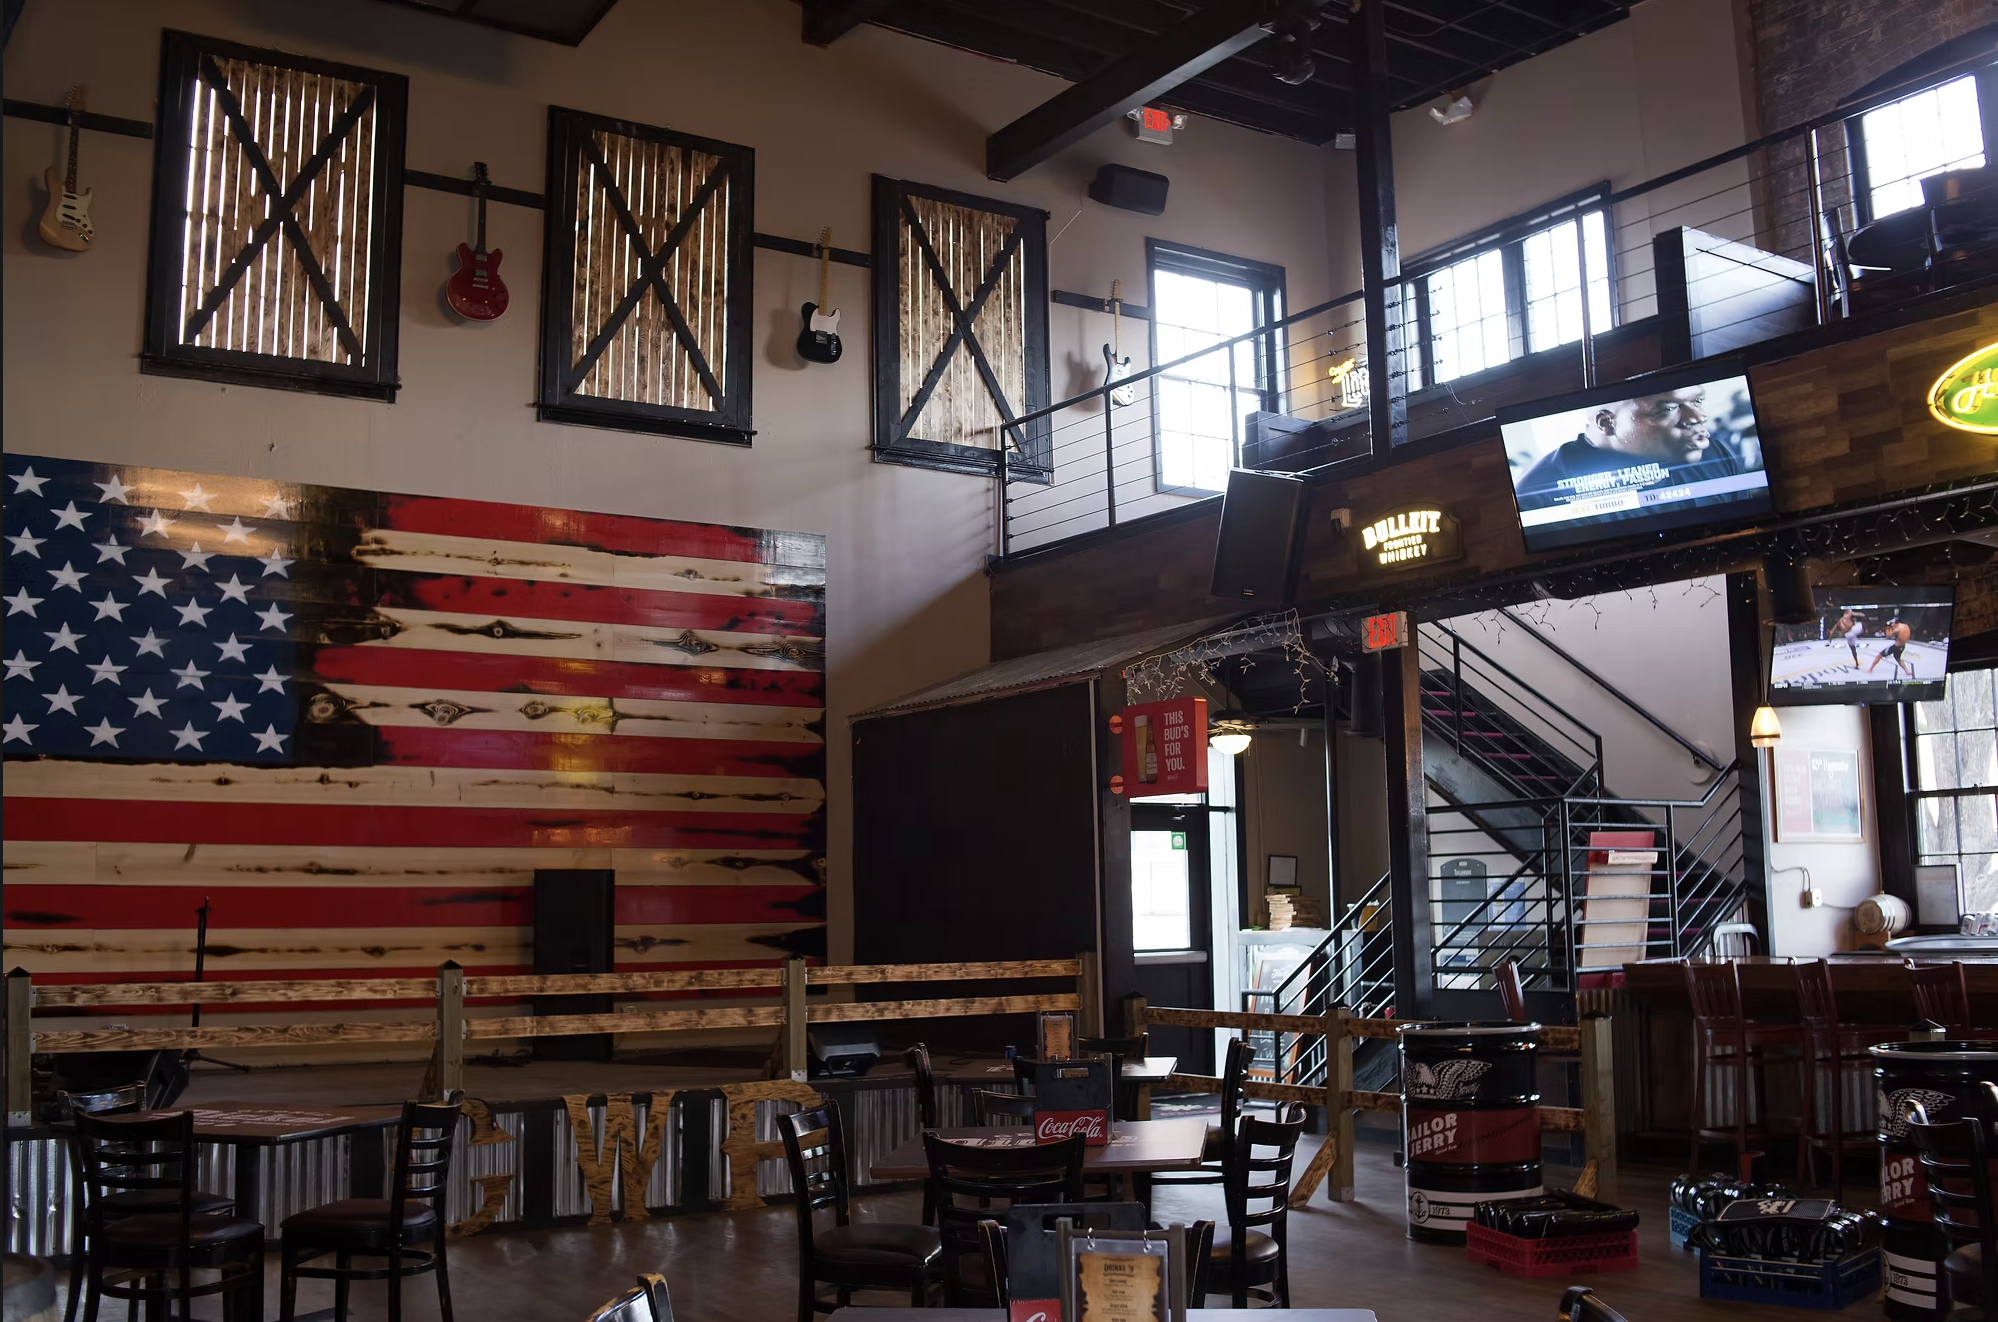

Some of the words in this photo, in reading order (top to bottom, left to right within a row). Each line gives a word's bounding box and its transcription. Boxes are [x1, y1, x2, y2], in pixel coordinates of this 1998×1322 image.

[1144, 108, 1167, 132] EXIT
[1659, 488, 1691, 500] 42424
[1383, 534, 1422, 551] FRONTIER
[1379, 544, 1427, 564] WHISKEY
[1368, 614, 1397, 648] EXIT
[1164, 710, 1184, 726] THIS
[1164, 725, 1189, 741] BUD'S
[1165, 742, 1181, 757] FOR
[1166, 757, 1185, 771] YOU.
[1410, 1128, 1457, 1157] JERRY
[1431, 1205, 1450, 1216] 1973
[1892, 1273, 1909, 1286] 1973
